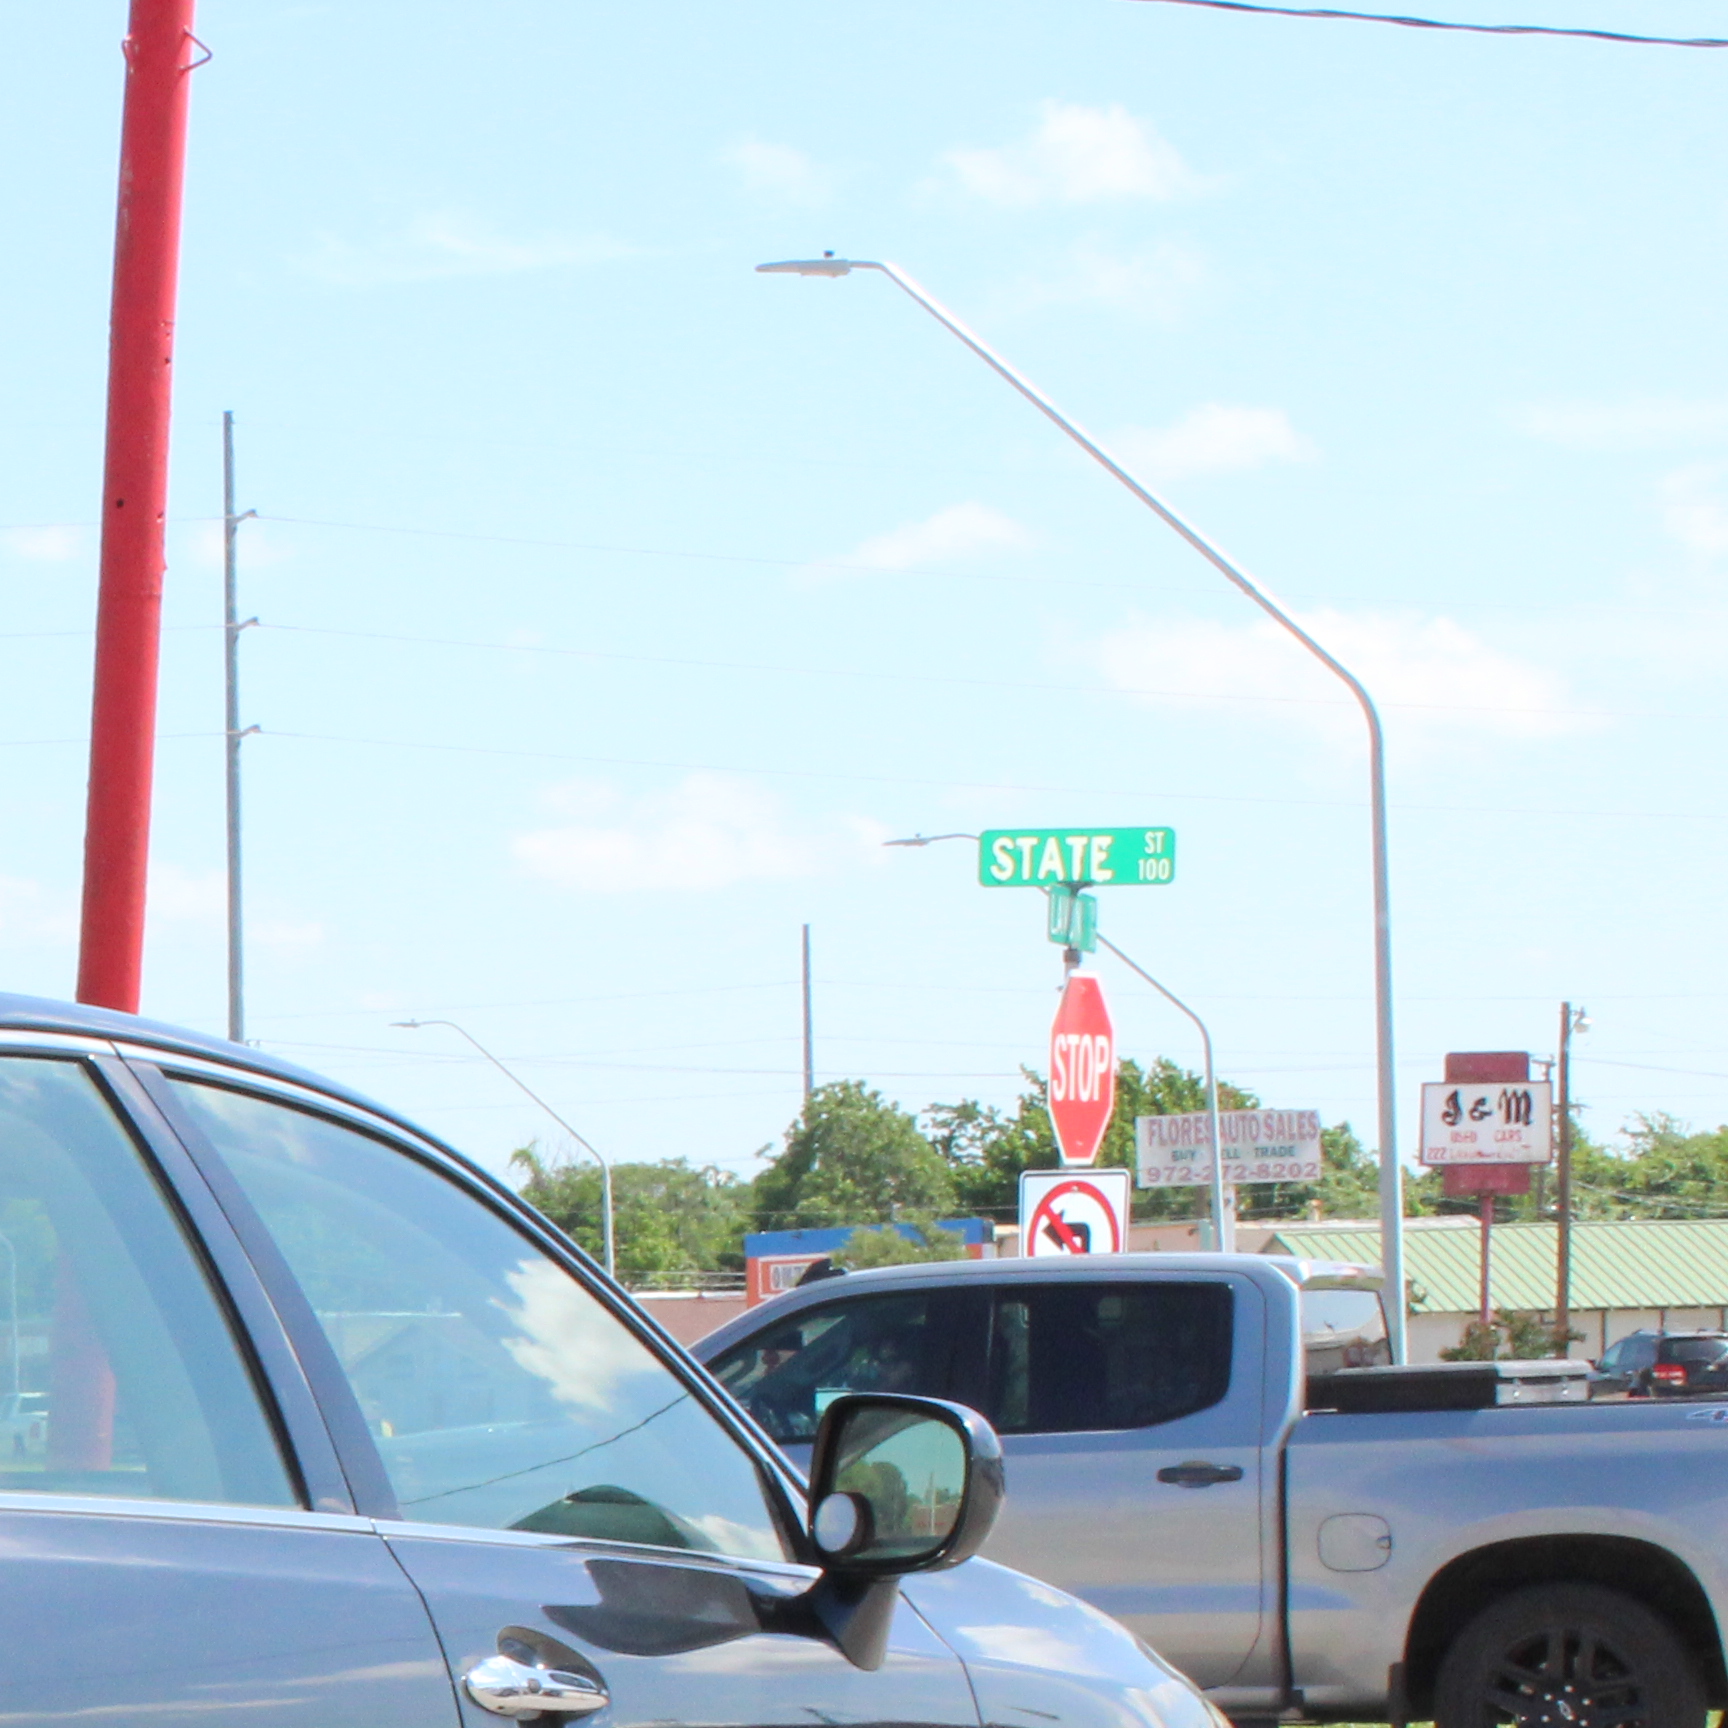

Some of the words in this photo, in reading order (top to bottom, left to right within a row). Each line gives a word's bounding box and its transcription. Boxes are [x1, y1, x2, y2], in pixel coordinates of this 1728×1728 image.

[990, 836, 1114, 882] STATE
[1144, 831, 1167, 854] ST
[1138, 858, 1171, 881] 100
[1052, 1033, 1110, 1102] STOP
[1498, 1088, 1532, 1127] M
[1148, 1114, 1213, 1147] FLORES
[1219, 1112, 1260, 1144] AUTO
[1264, 1111, 1318, 1141] SALES
[1171, 1150, 1197, 1162] BUY
[1220, 1148, 1241, 1160] ELL
[1255, 1146, 1296, 1159] TRADE
